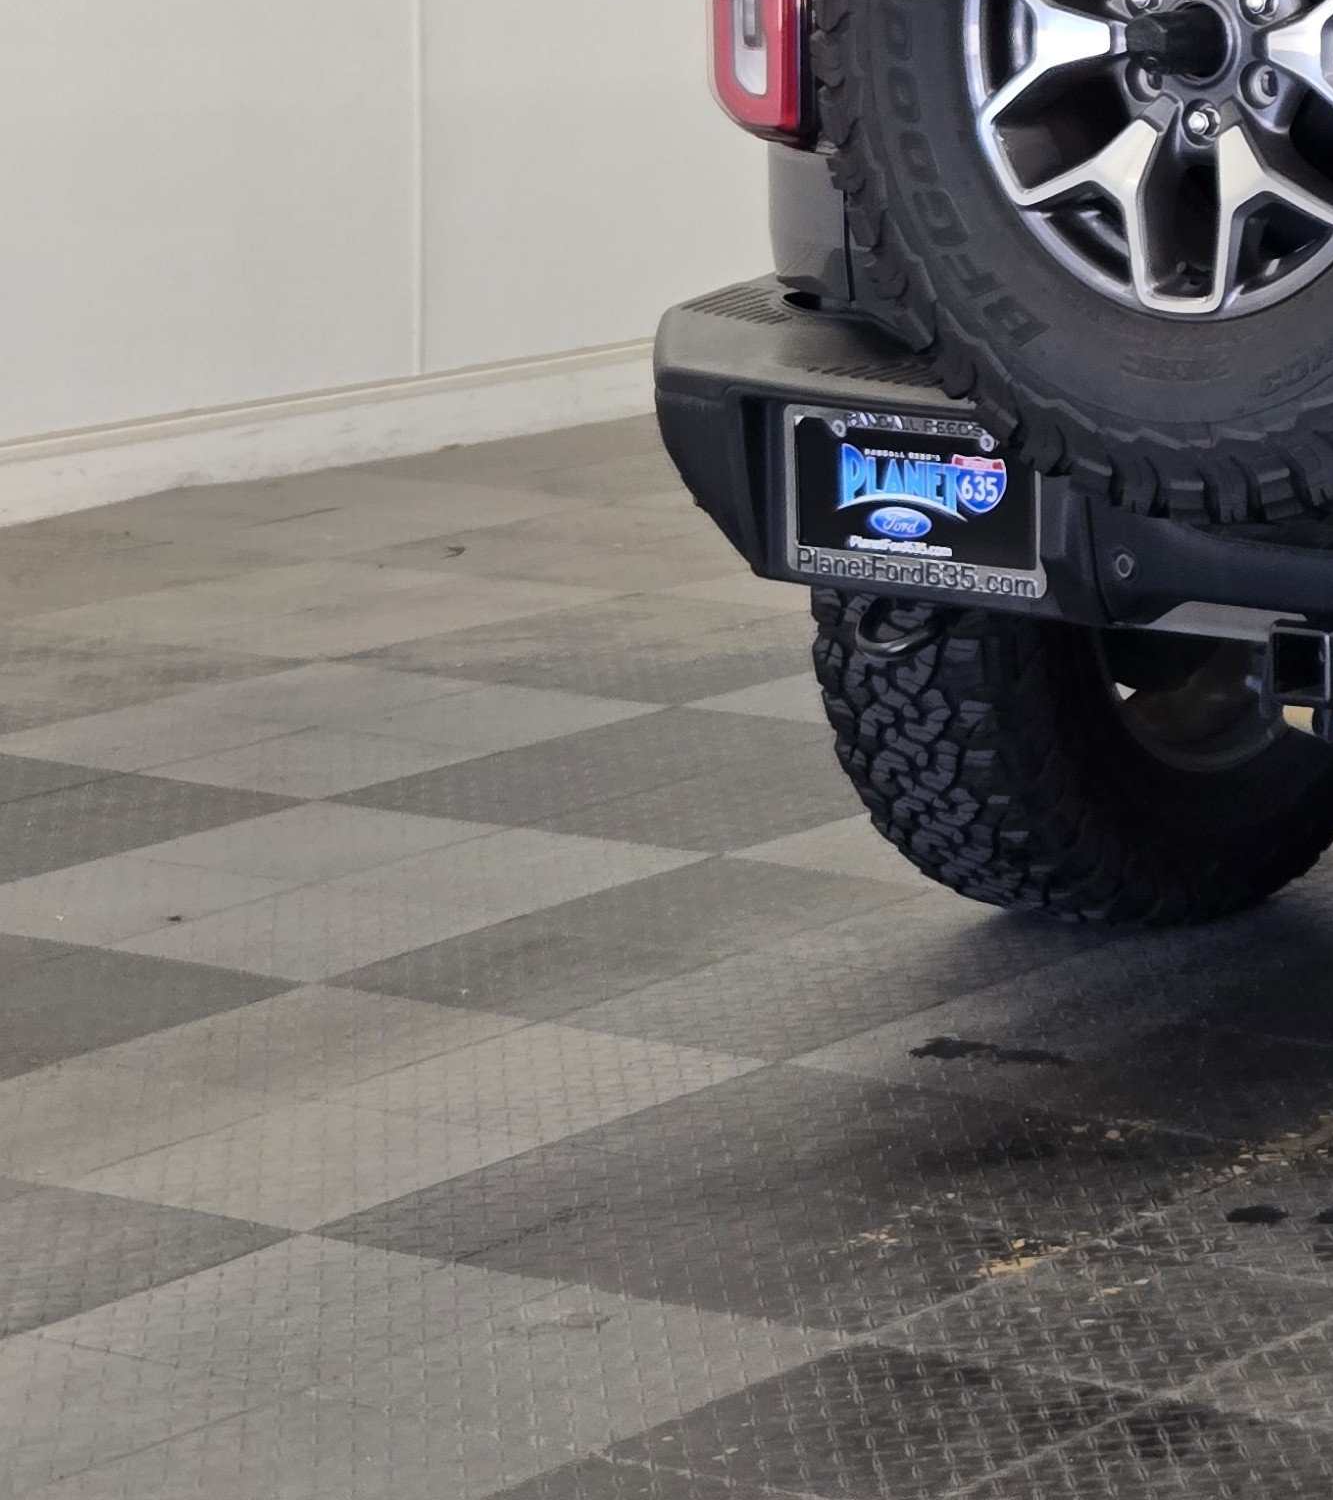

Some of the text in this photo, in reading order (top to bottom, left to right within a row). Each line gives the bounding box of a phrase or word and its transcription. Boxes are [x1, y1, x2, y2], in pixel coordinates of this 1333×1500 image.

[841, 443, 999, 512] PLANET 635
[882, 513, 920, 534] Ford
[797, 547, 1038, 597] PlanetFord635.com
